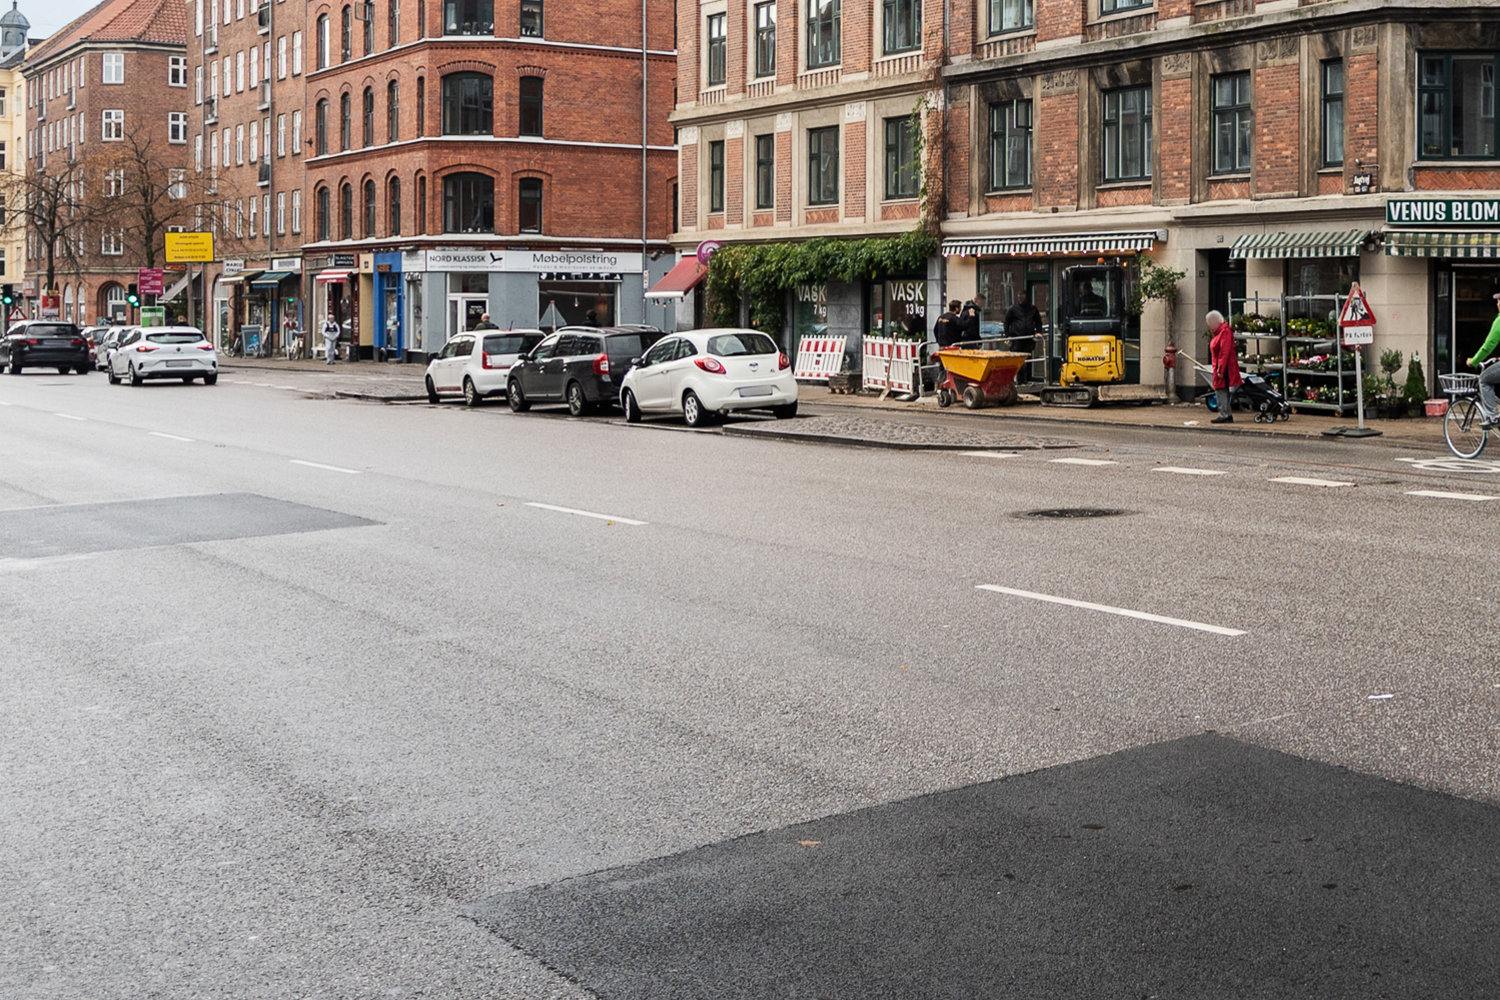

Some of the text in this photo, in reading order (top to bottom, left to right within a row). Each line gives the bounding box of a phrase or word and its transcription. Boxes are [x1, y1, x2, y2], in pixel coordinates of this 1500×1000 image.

[1389, 201, 1446, 221] VENUS
[429, 255, 486, 263] NORD KLASSISK
[532, 253, 618, 266] Møbelpolstring
[798, 284, 827, 302] VASK
[891, 282, 924, 301] VASK
[813, 304, 827, 317] 7 kg
[905, 303, 925, 317] 13 kg
